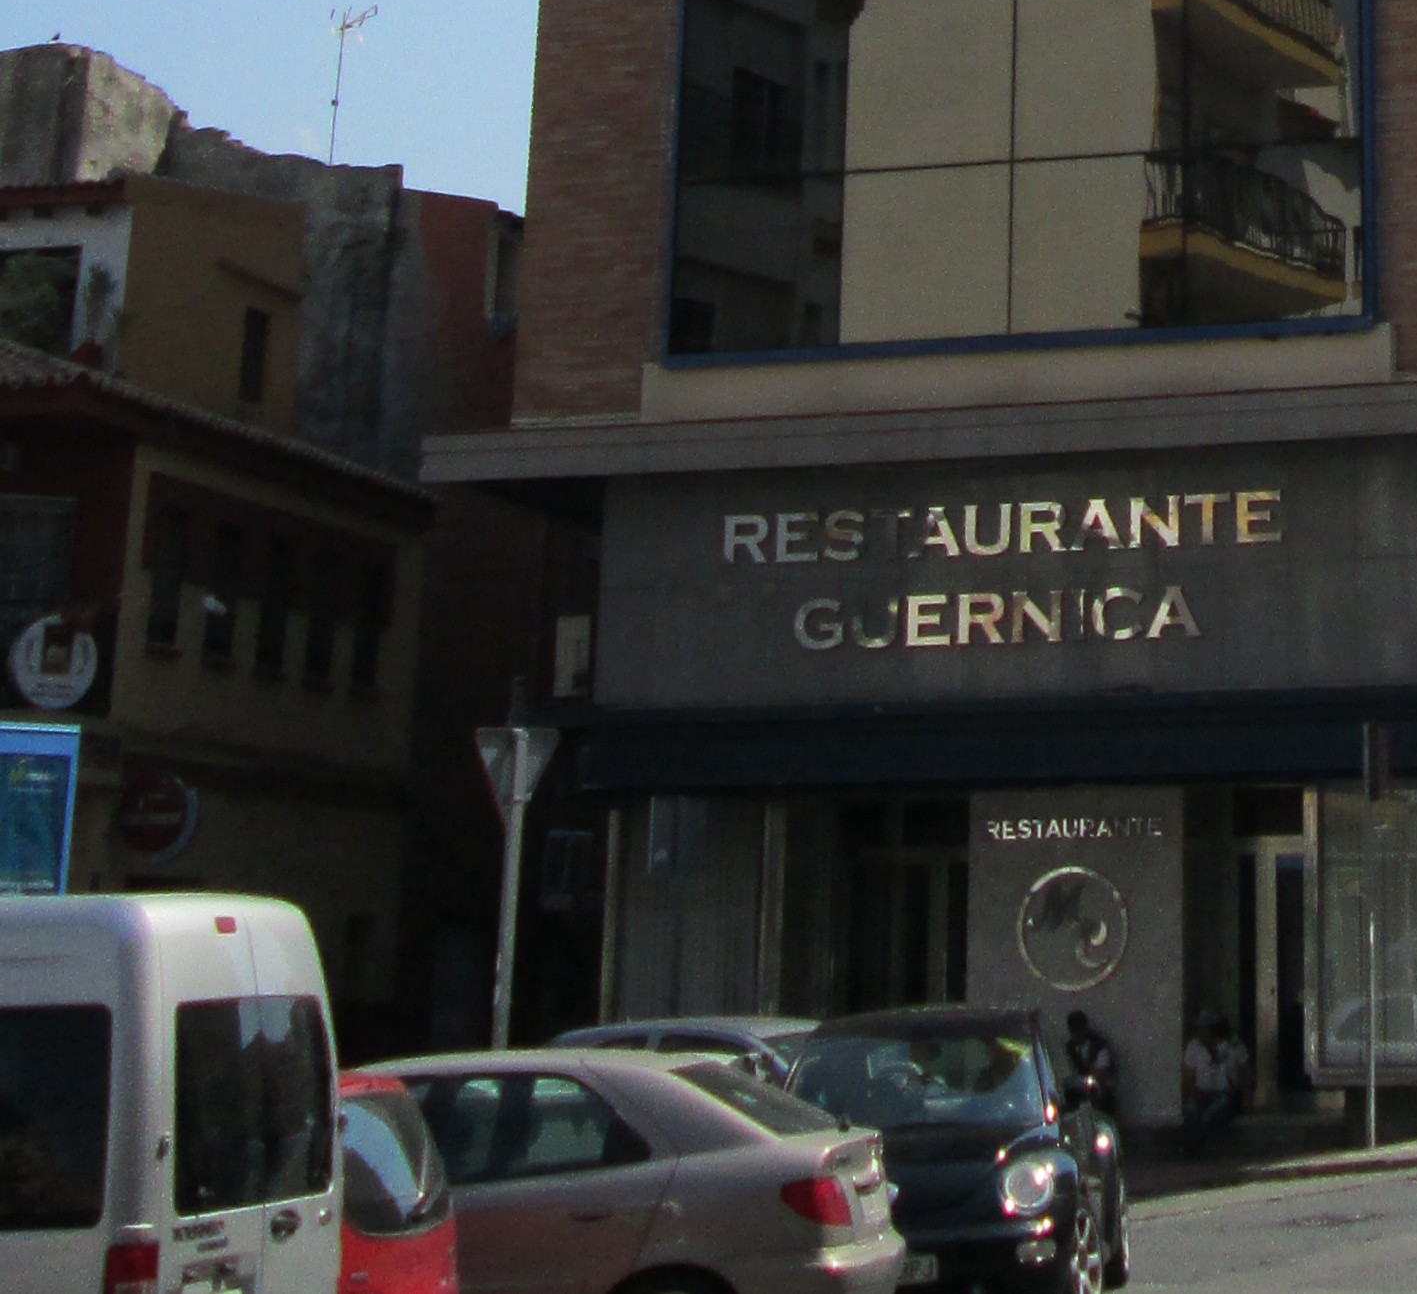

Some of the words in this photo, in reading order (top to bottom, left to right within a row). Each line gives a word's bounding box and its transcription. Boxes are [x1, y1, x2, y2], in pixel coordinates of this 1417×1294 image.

[722, 489, 1283, 565] RESTAURANTE
[793, 584, 1201, 651] GUERNICA
[987, 816, 1163, 840] RESTAURANTE
